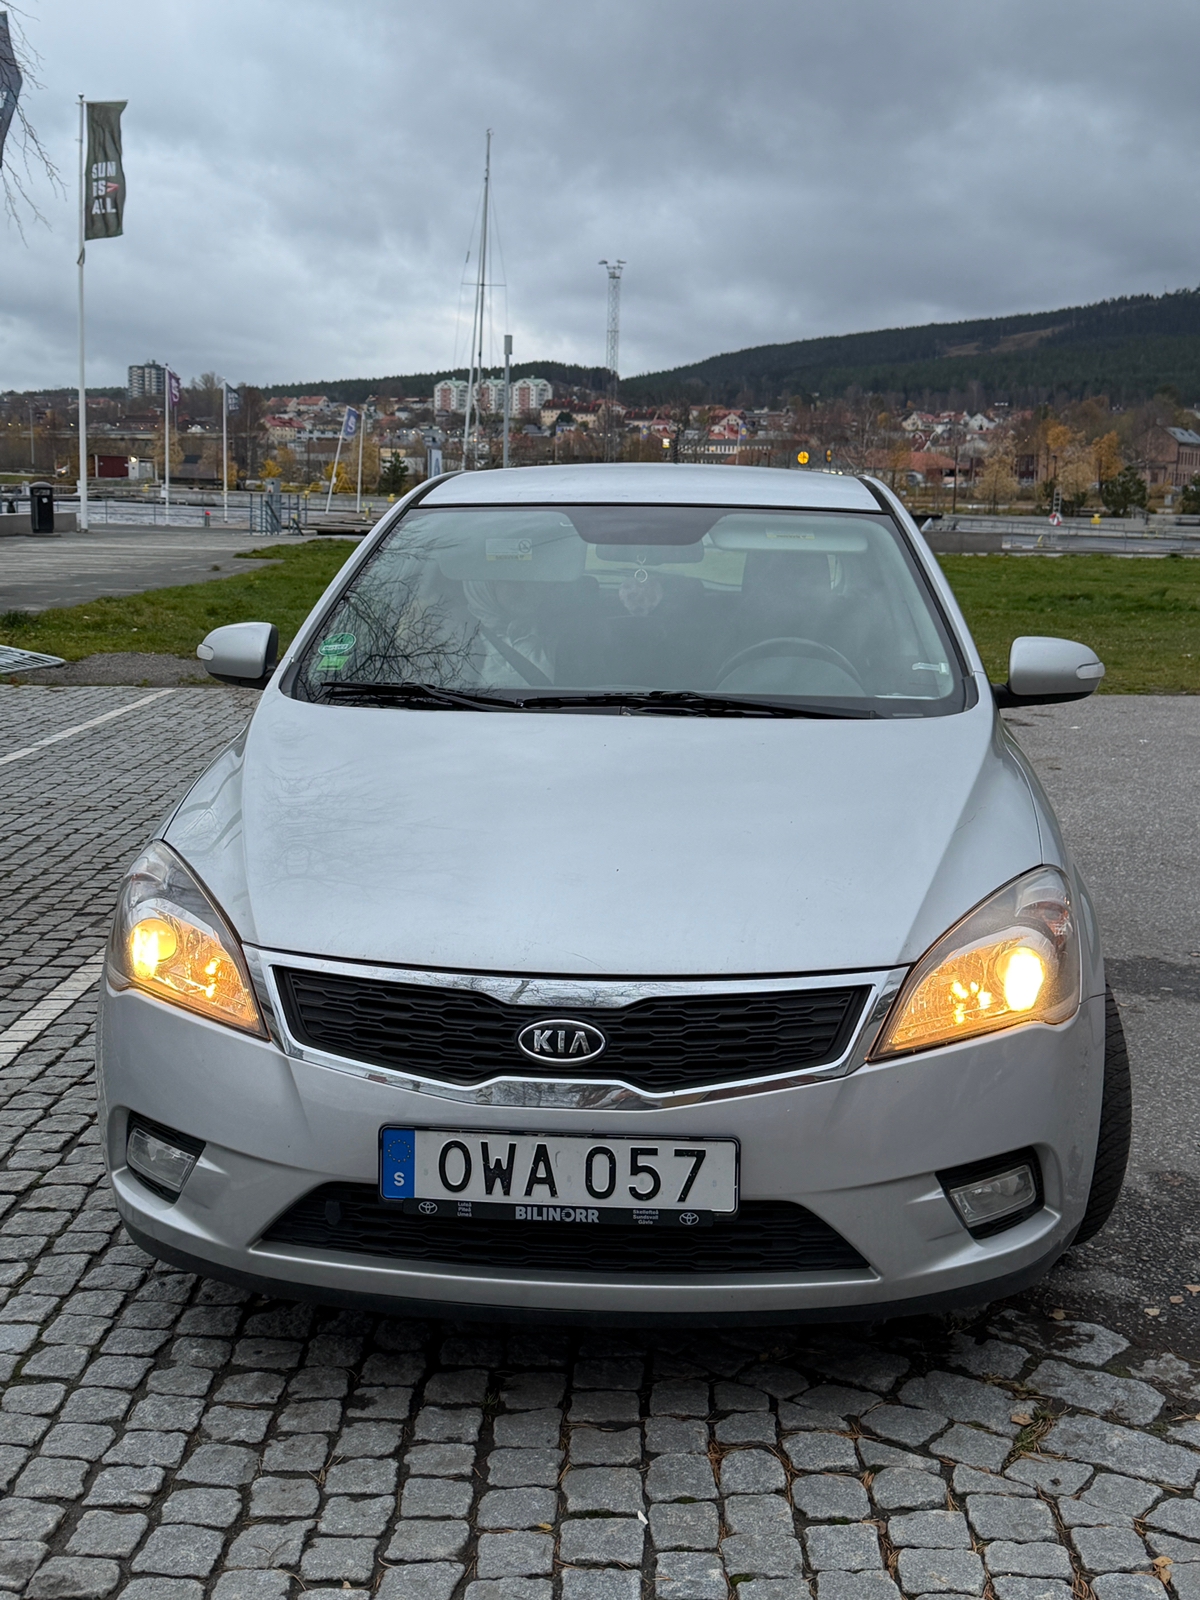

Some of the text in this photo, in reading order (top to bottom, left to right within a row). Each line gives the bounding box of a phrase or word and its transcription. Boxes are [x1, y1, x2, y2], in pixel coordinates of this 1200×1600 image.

[92, 161, 116, 178] SUN
[92, 198, 117, 214] ALL
[533, 1029, 591, 1054] KIA
[394, 1172, 405, 1187] S
[438, 1139, 707, 1203] OWA 057
[515, 1206, 599, 1223] BILINORR
